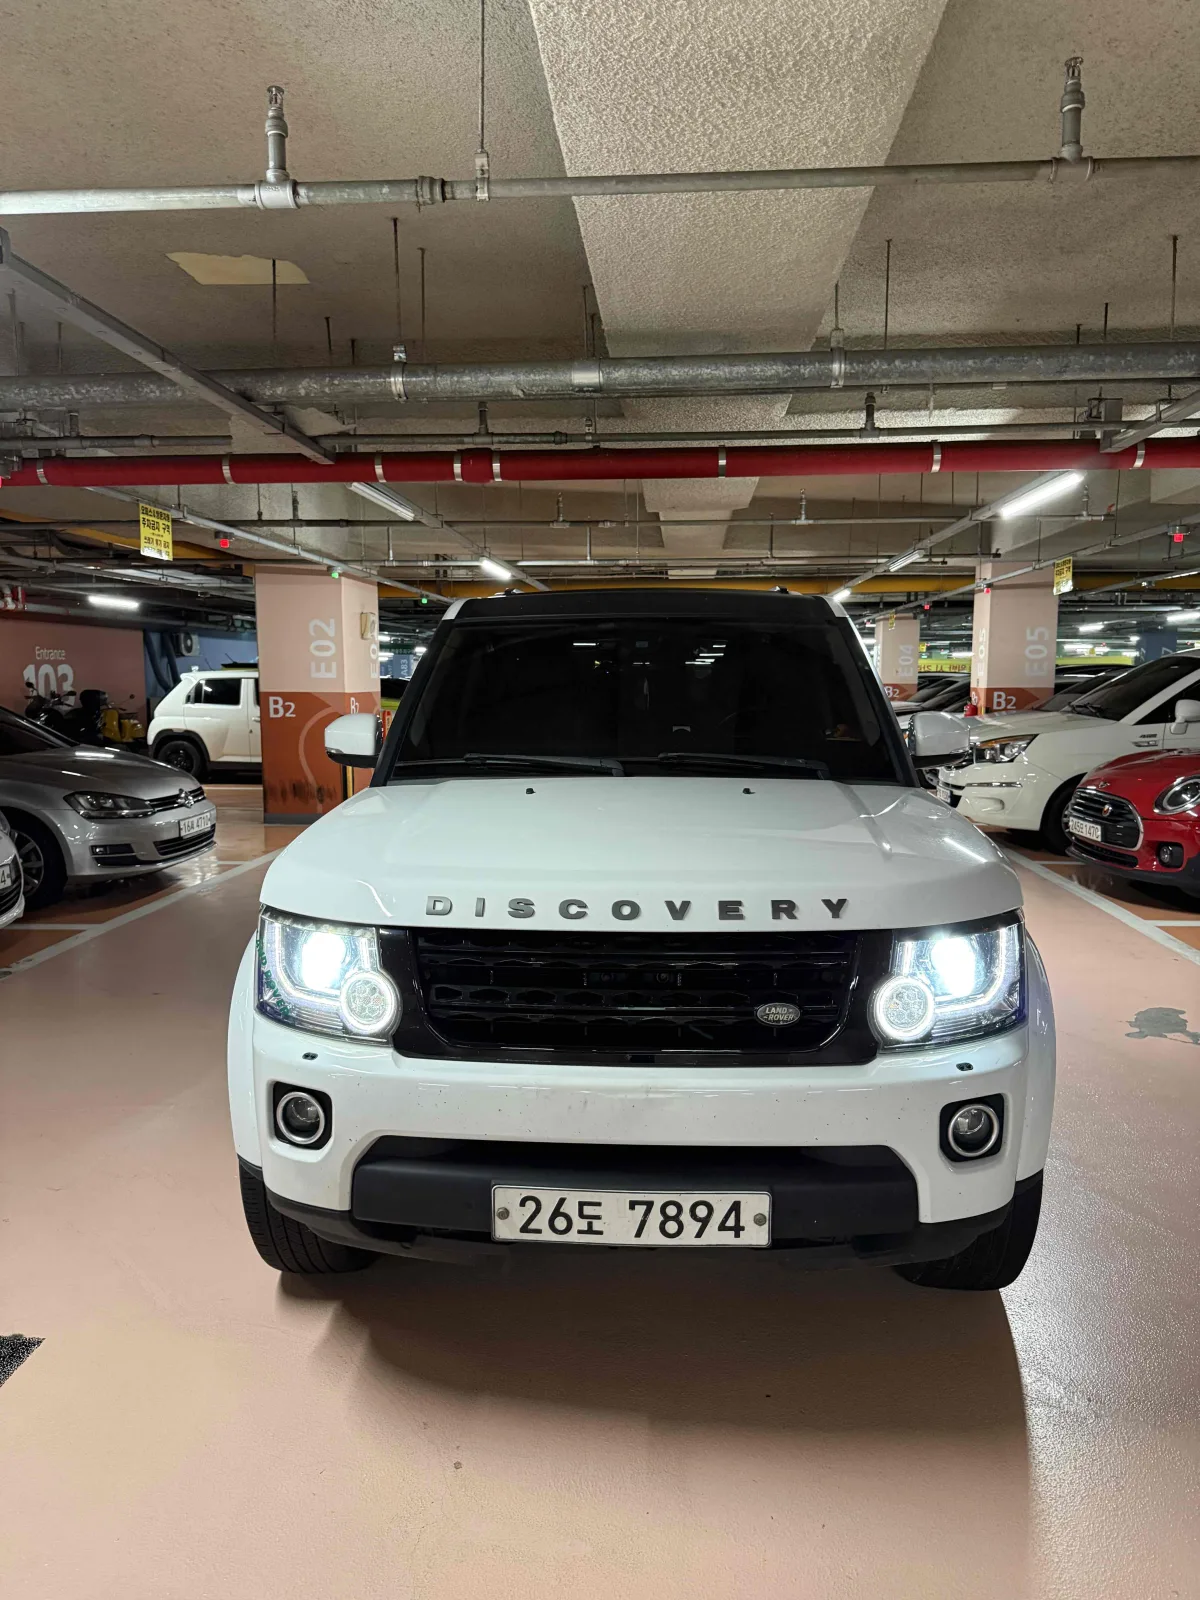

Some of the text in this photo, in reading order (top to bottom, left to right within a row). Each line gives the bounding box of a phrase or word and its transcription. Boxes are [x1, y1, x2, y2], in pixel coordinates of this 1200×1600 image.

[35, 646, 66, 661] Entrance
[309, 618, 337, 679] E02
[370, 638, 378, 679] E0
[1024, 626, 1049, 677] E05
[268, 696, 297, 718] B2
[992, 691, 1017, 711] B2
[425, 895, 848, 921] DISCOVERY
[264, 970, 290, 1016] ROVER
[519, 1195, 746, 1239] 26도 7894
